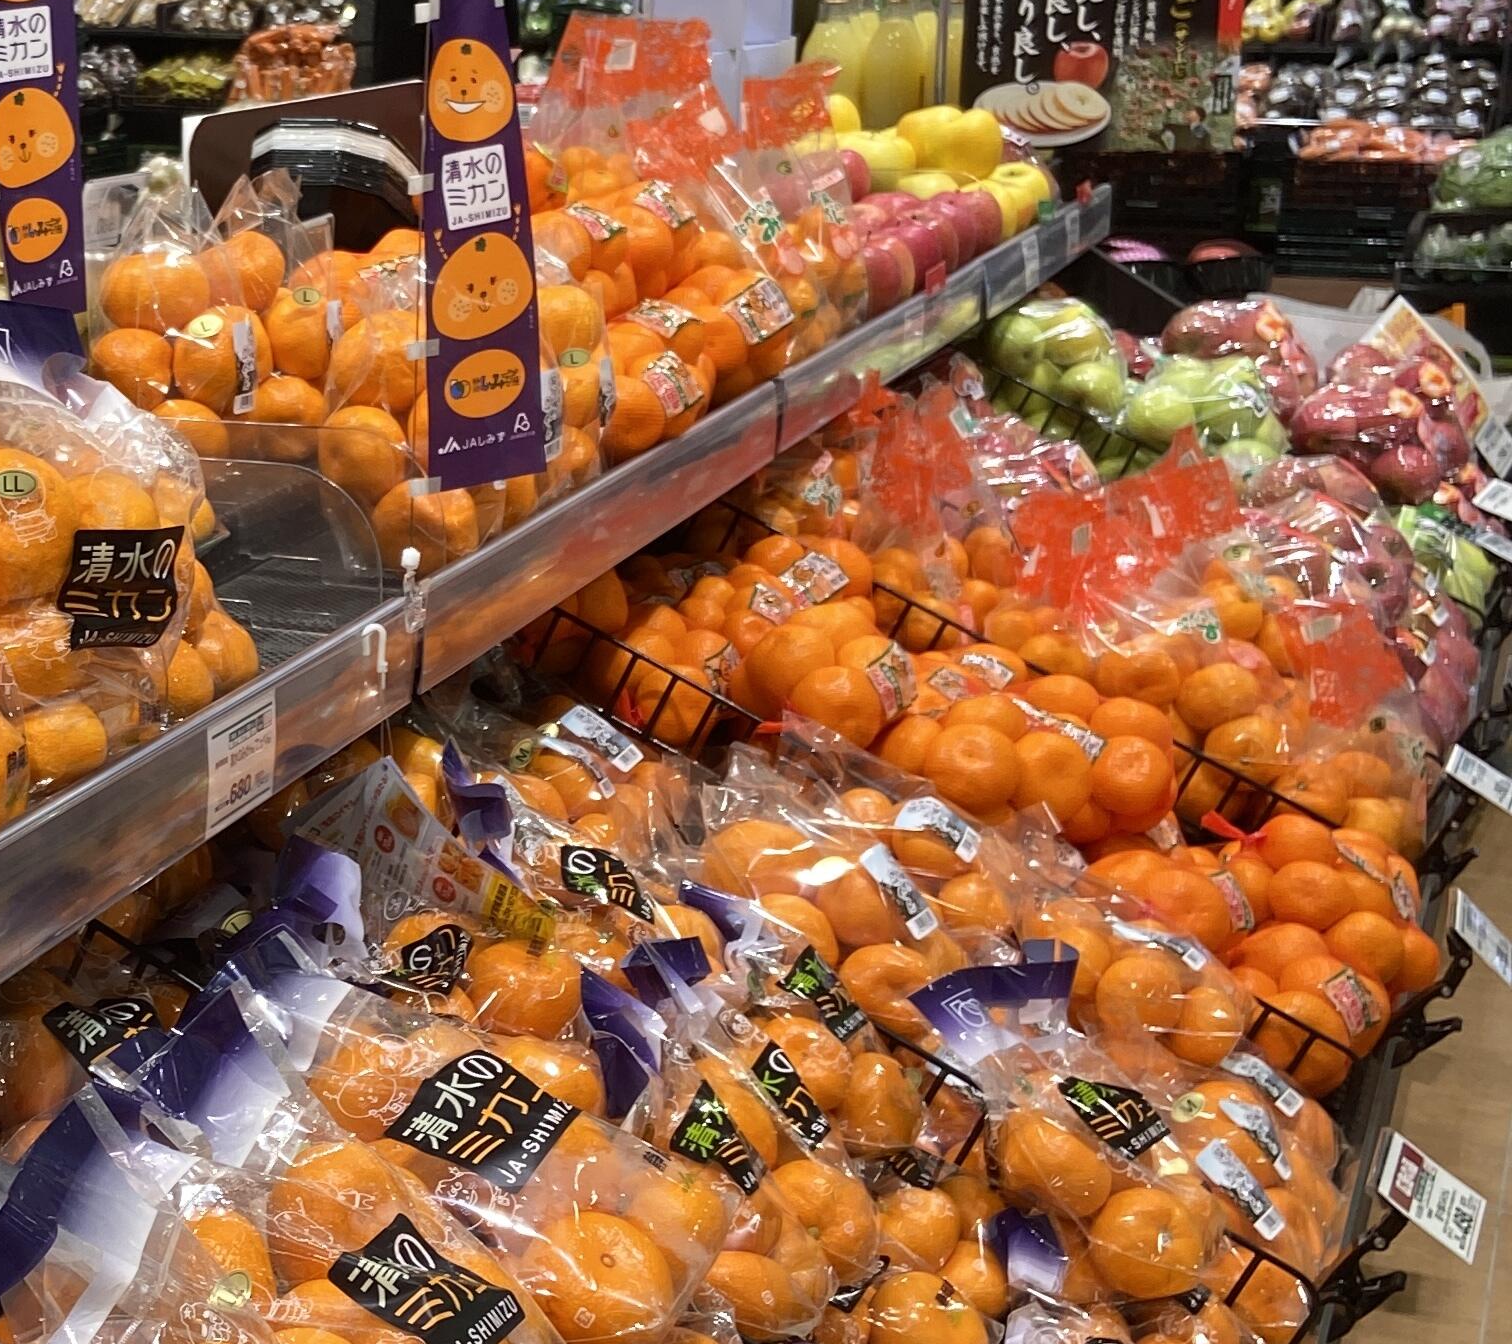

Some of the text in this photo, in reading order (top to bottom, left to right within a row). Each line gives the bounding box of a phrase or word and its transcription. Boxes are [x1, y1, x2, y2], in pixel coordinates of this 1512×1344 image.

[445, 152, 502, 183] 清水の
[447, 178, 506, 207] ミカン
[451, 207, 509, 227] JA-SHIMIZU
[3, 475, 25, 493] LL
[73, 537, 175, 584] 清水の
[402, 1052, 504, 1151] 清水の
[498, 1097, 575, 1184] JA-SHIMIZ
